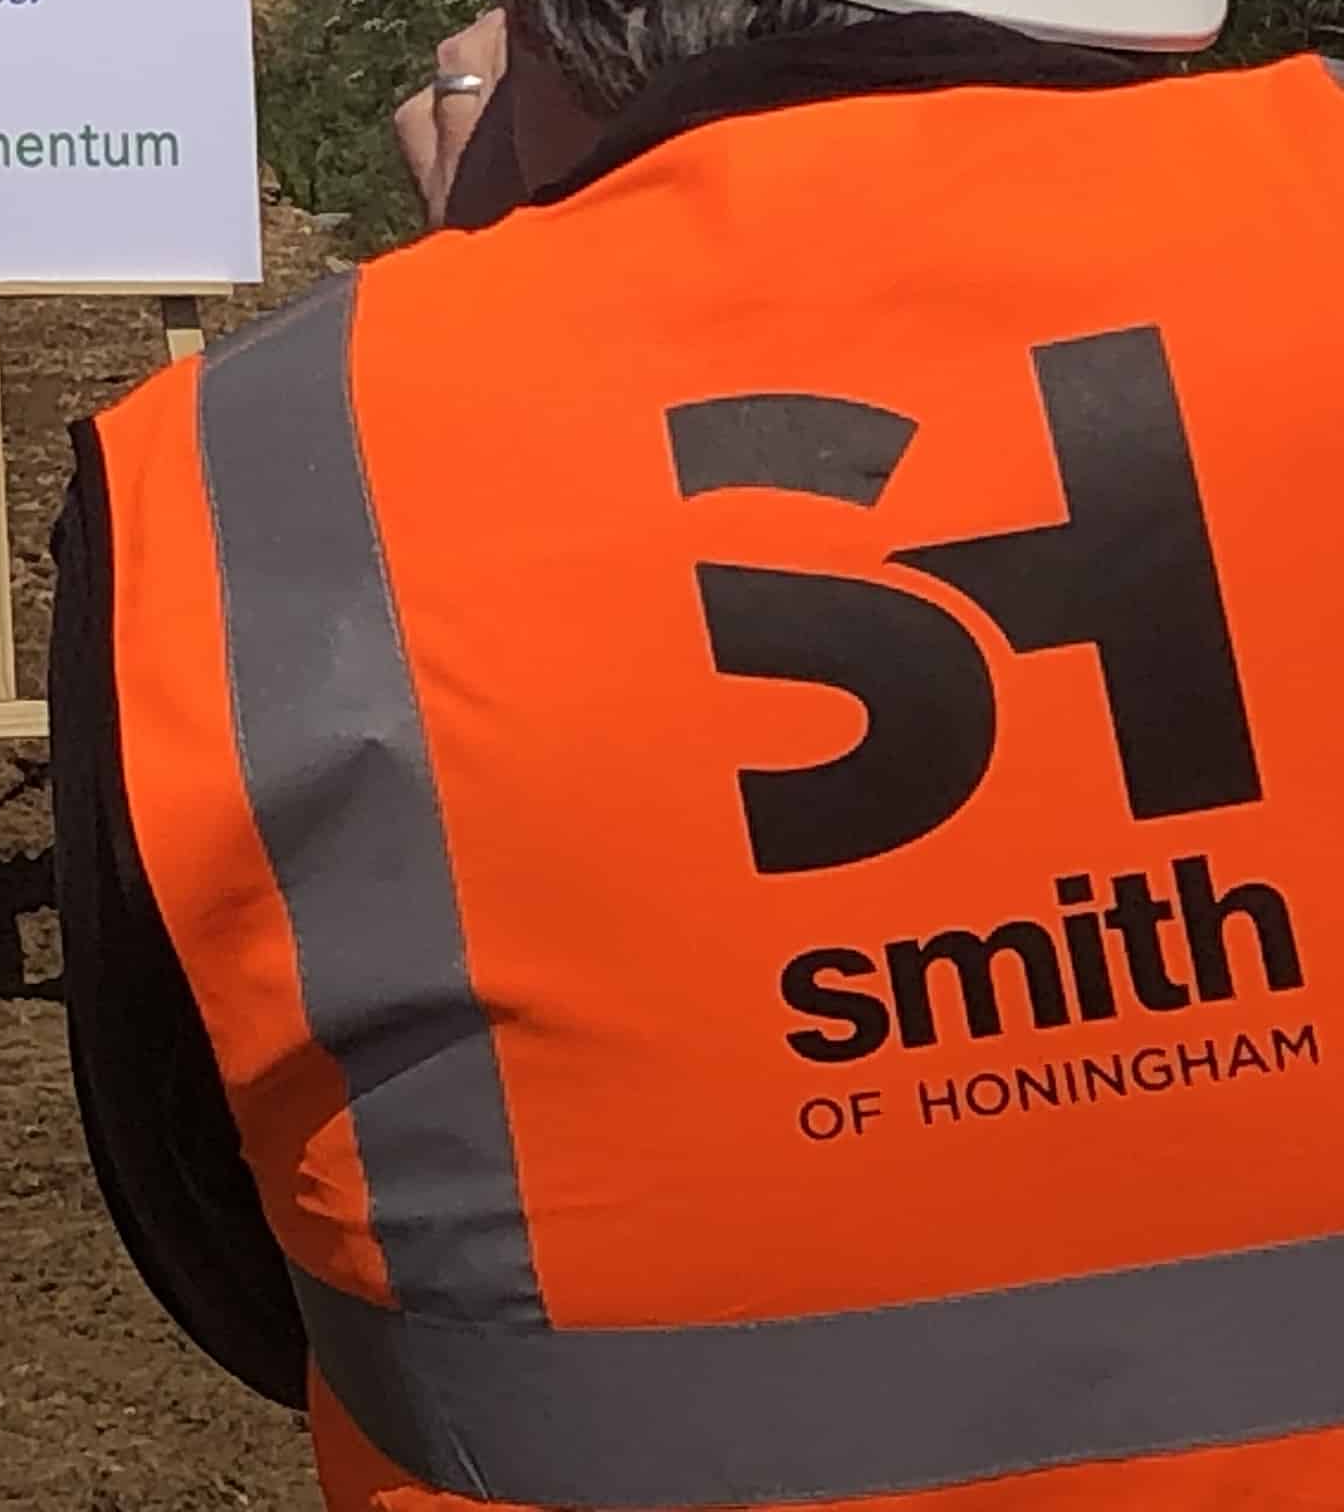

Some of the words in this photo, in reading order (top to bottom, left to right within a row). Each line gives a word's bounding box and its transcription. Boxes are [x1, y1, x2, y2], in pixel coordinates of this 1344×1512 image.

[780, 854, 1305, 1064] smith
[798, 1090, 884, 1143] OF
[918, 1023, 1321, 1126] HONINGHAM
